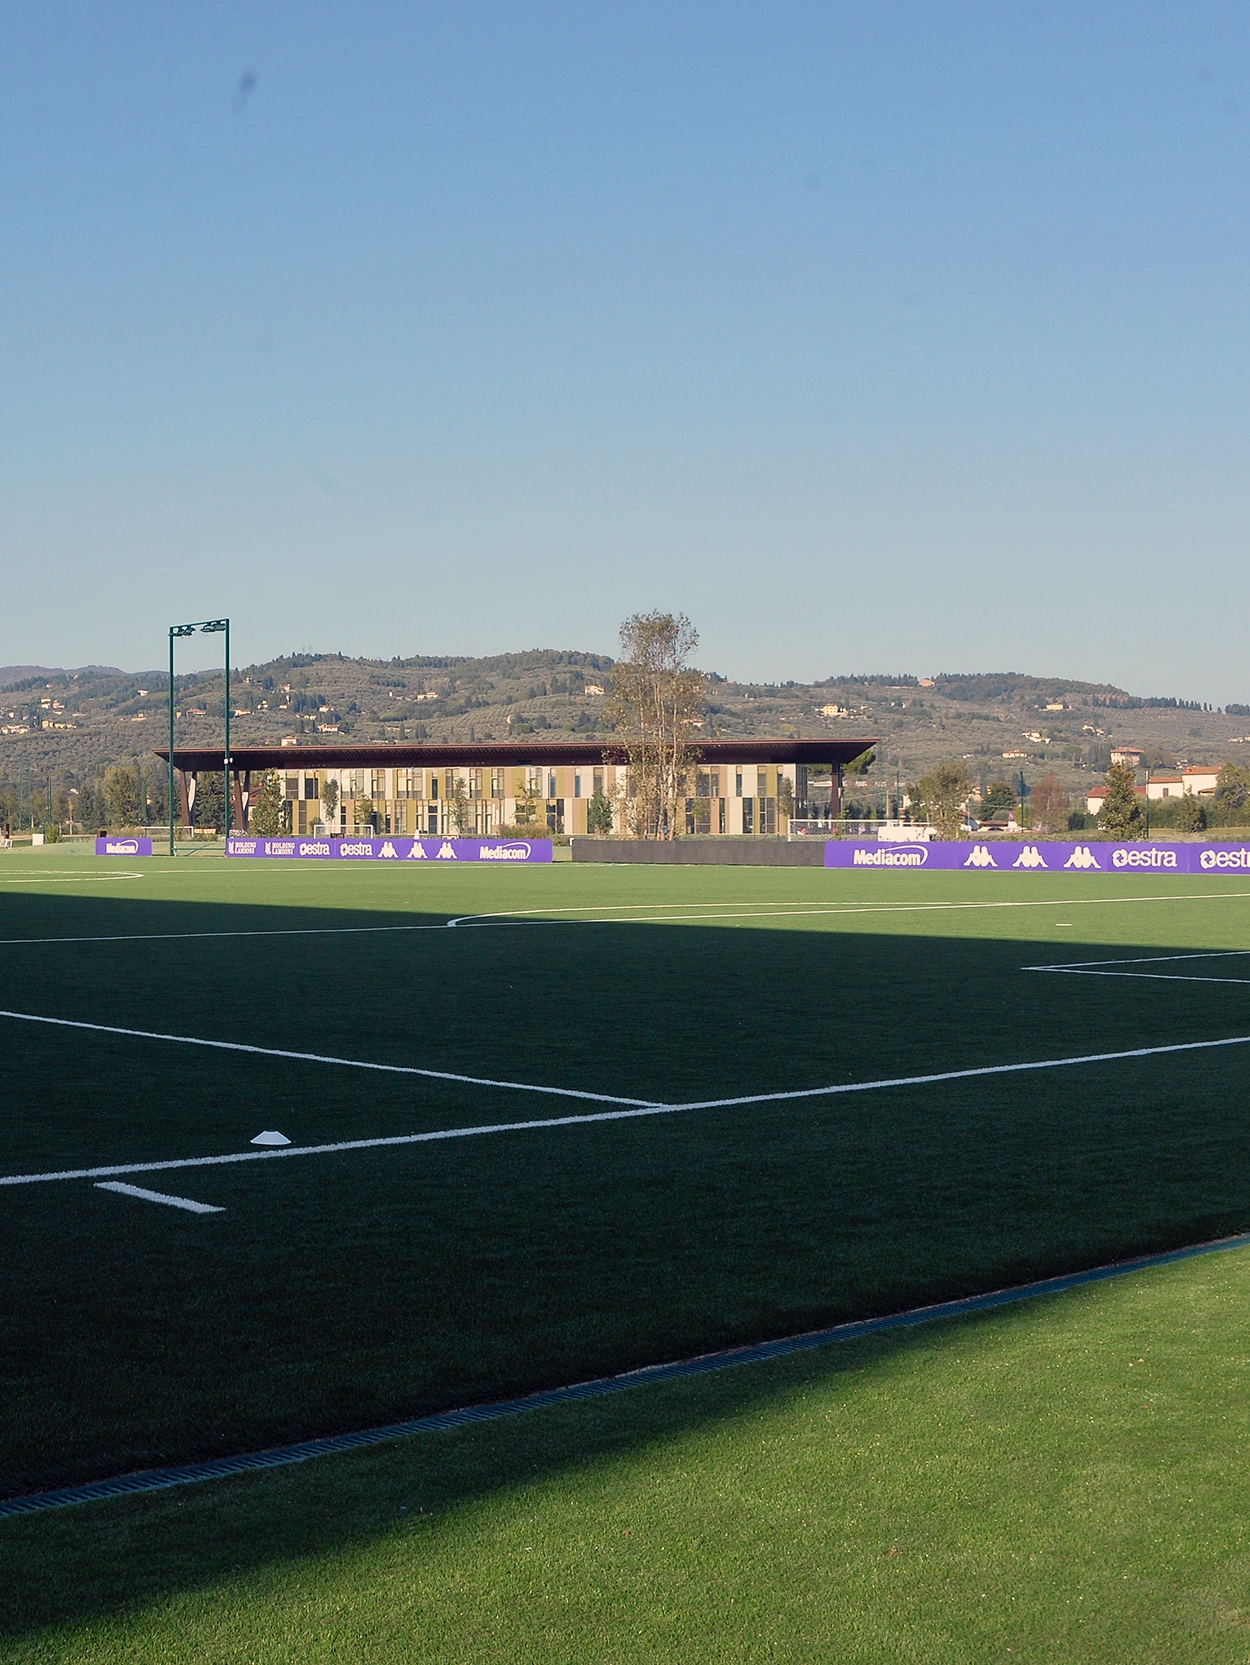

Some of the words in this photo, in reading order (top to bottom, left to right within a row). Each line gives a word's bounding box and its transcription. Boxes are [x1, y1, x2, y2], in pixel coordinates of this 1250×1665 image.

[479, 845, 526, 860] Mediacom
[853, 848, 921, 866] Mediacom
[1127, 848, 1178, 868] estra
